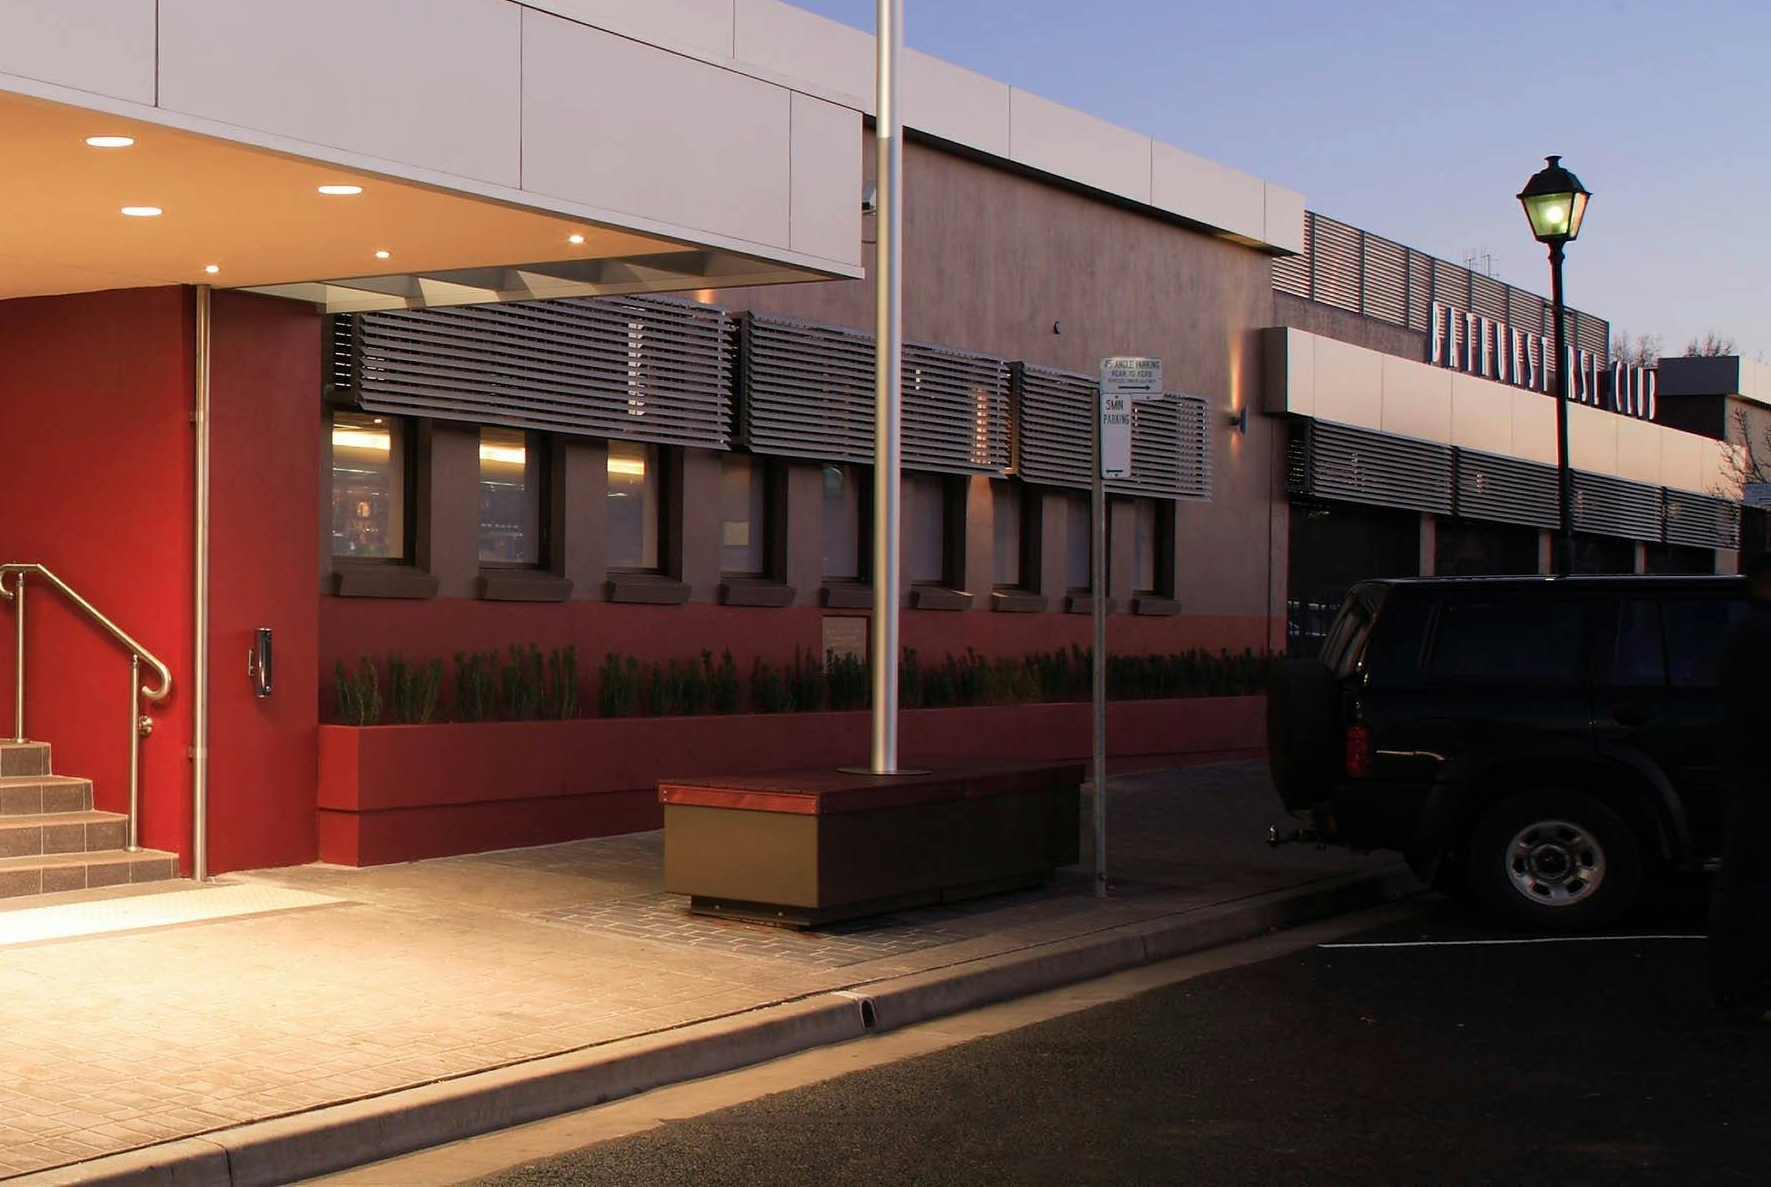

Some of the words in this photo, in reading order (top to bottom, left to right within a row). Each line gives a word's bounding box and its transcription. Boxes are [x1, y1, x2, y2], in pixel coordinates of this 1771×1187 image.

[1135, 360, 1160, 370] PARKING
[1431, 300, 1548, 392] BATHURST
[1567, 345, 1599, 405] RSL
[1614, 360, 1656, 420] CLUB
[1103, 414, 1130, 424] PARKING
